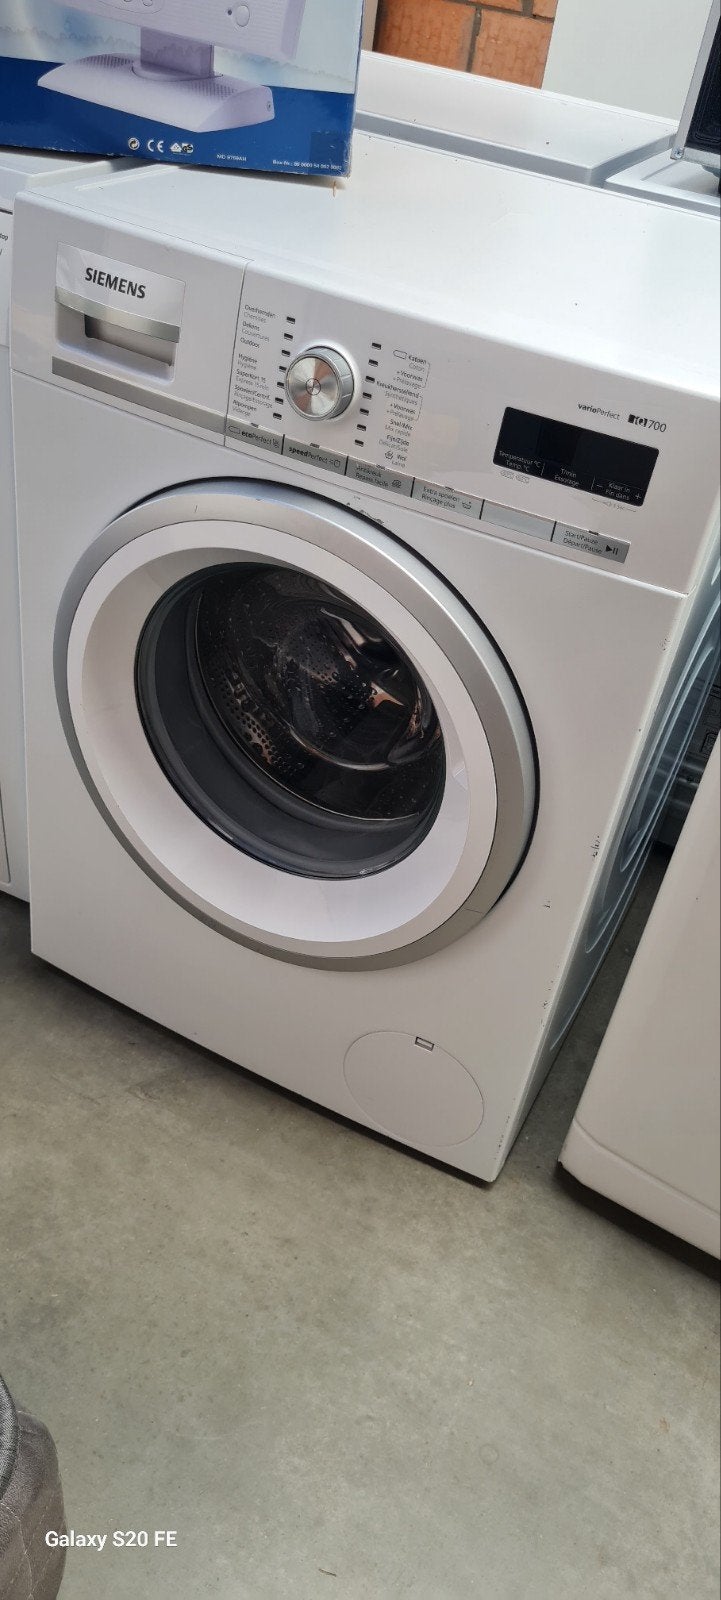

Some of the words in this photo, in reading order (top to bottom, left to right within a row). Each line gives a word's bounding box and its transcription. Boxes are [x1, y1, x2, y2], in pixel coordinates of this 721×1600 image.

[84, 267, 147, 299] SIEMENS
[577, 402, 621, 421] varioPerfect
[241, 430, 272, 445] ecoPerfect
[288, 446, 328, 464] speedPerfect
